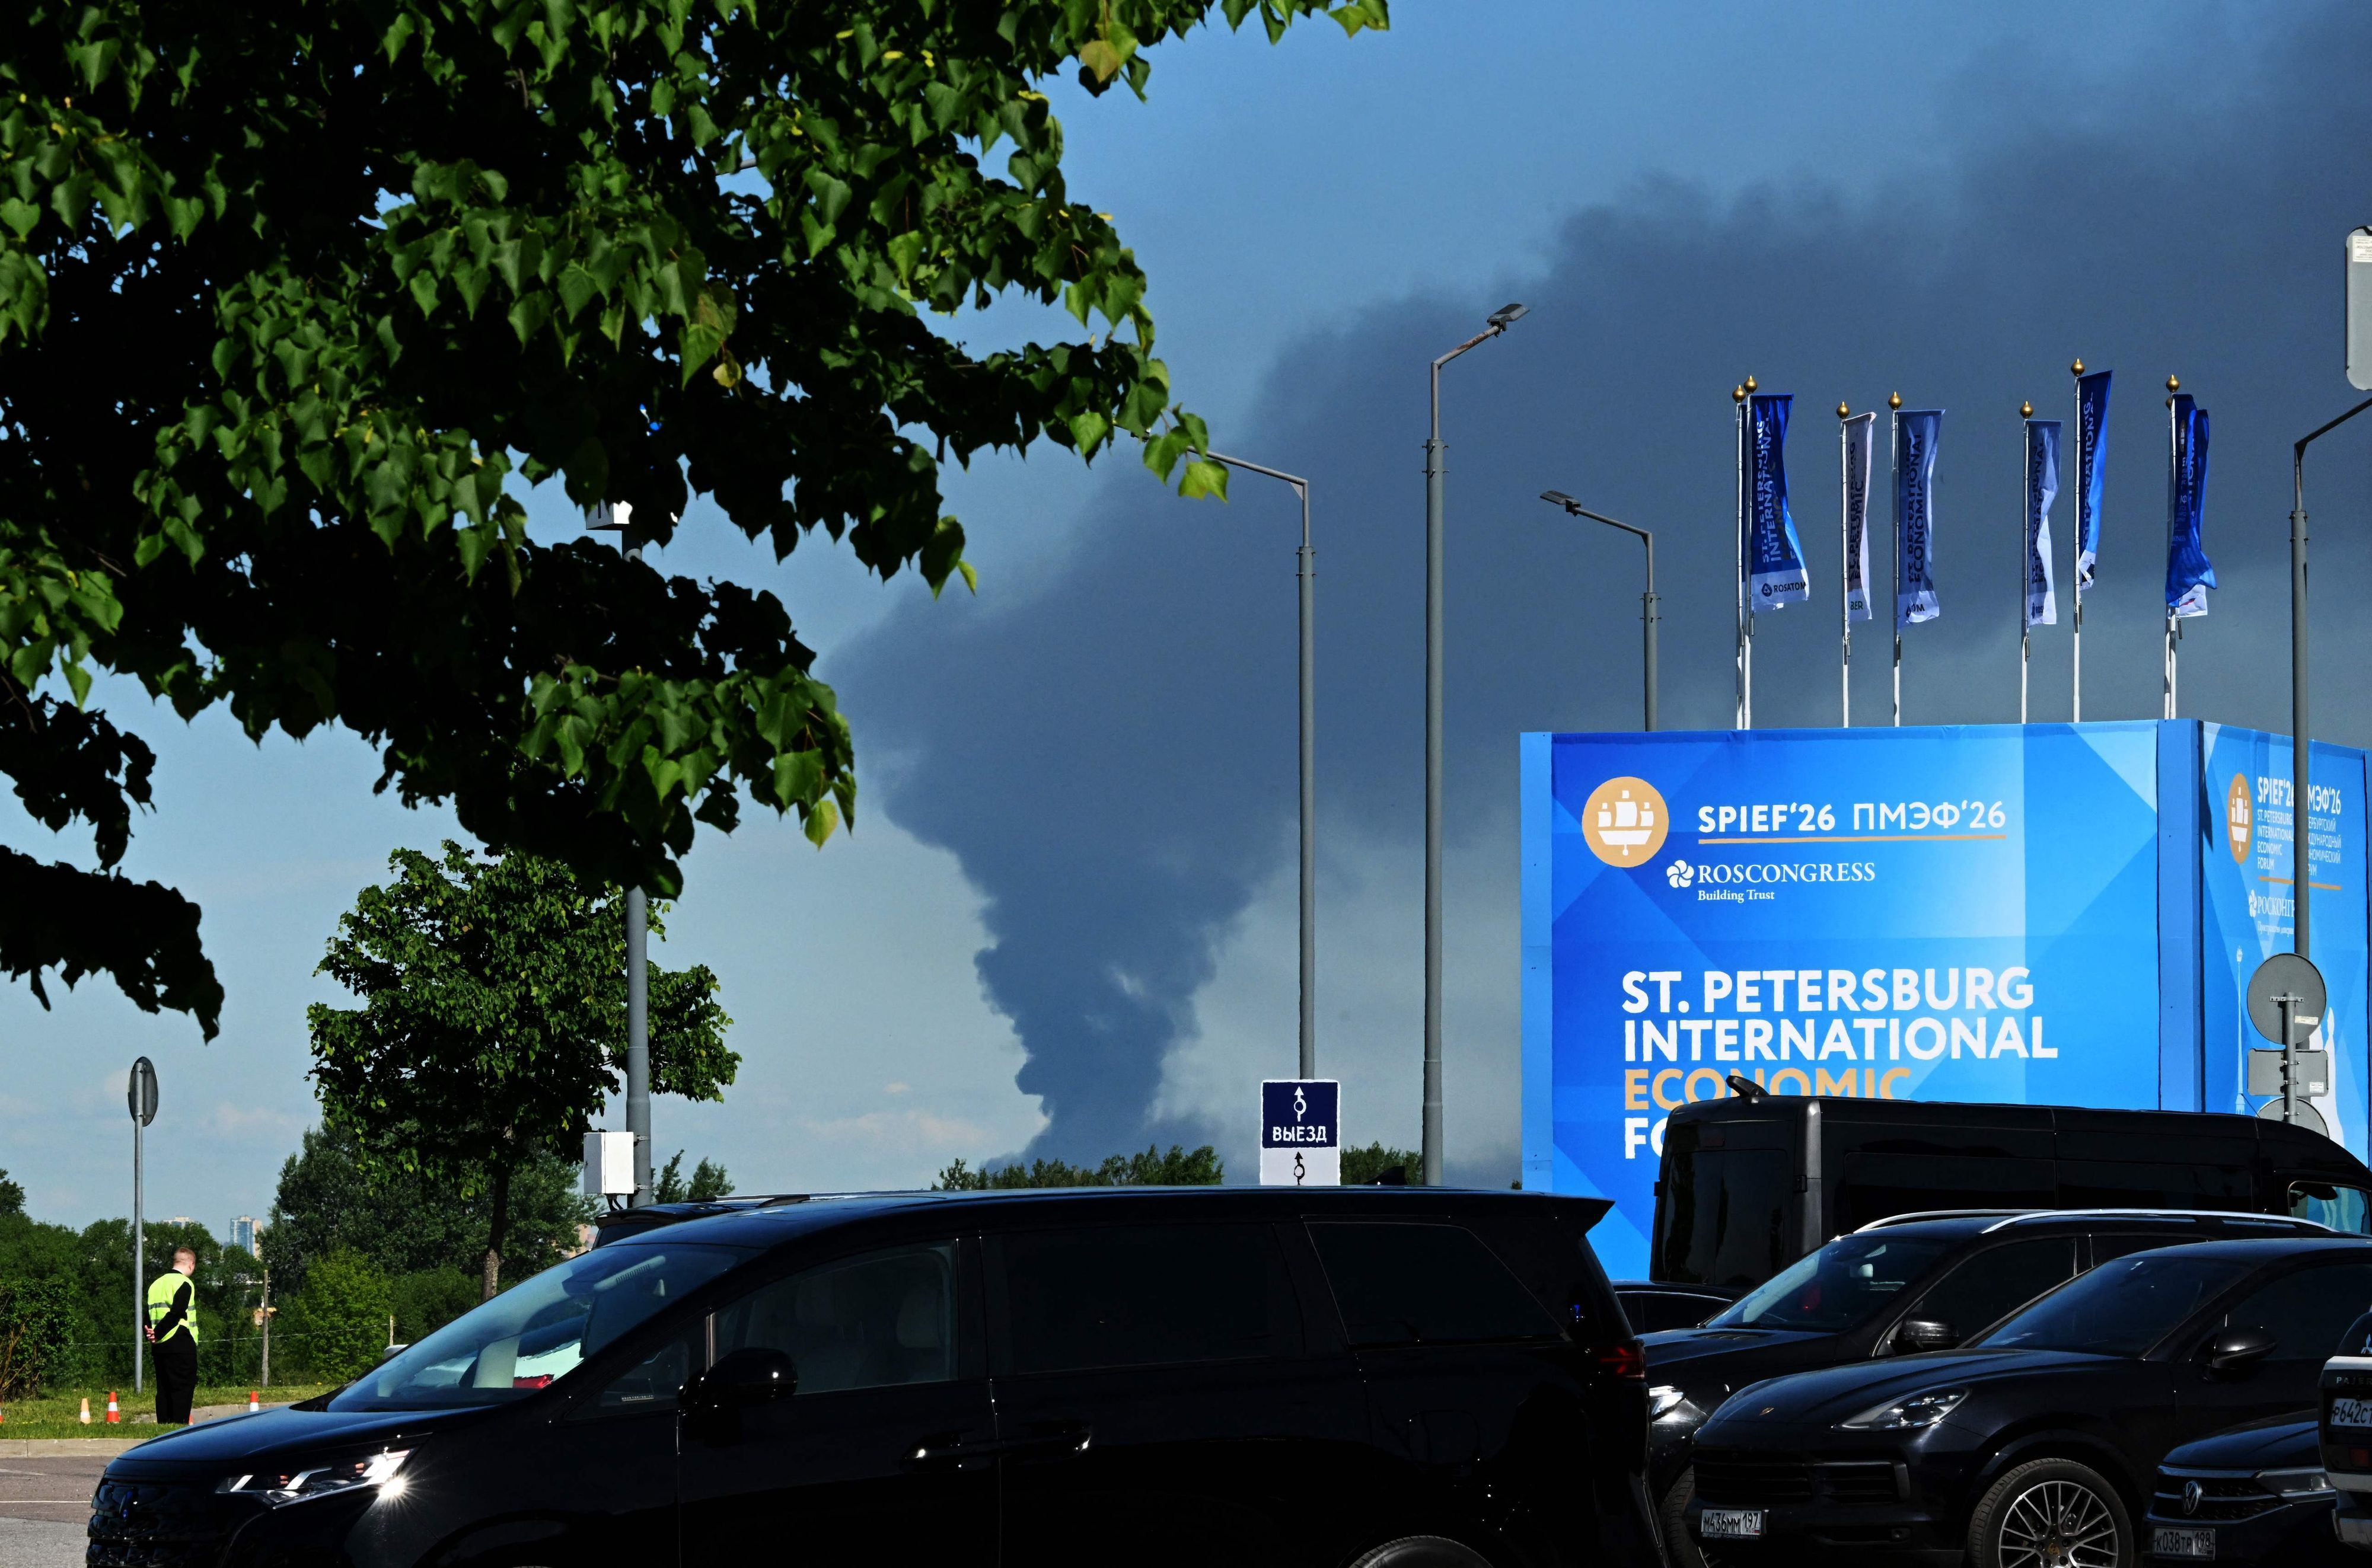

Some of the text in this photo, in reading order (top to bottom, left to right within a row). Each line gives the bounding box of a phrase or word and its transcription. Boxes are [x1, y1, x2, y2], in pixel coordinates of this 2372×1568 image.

[1774, 582, 1806, 593] ROSATOM
[2307, 784, 2342, 815] МЭФ'26
[1698, 799, 2006, 833] SPIEF'26 ПМЭФ'26
[2264, 810, 2293, 826] PETERSBURG
[2308, 816, 2336, 832] ЕРБУРГСКИЙ
[2257, 825, 2294, 842] INTERNATIONAL
[2307, 832, 2342, 848] ДУНАРОДНЫЙ
[2257, 841, 2282, 856] ECONOMIC
[2308, 848, 2341, 864] НОМИЧЕСКИЙ
[2257, 857, 2275, 871] FORUM
[1697, 863, 1876, 883] ROSCONGRESS
[1697, 889, 1775, 903] Building Trust
[2257, 896, 2294, 918] РОСКОНГР
[1622, 966, 2034, 1014] ST. PETERSBURG
[1625, 1016, 2059, 1062] INTERNATIONAL
[1273, 1125, 1327, 1144] ВЫЕЗД
[1703, 1512, 1759, 1533] М436ММ 197
[2195, 1531, 2211, 1548] 198
